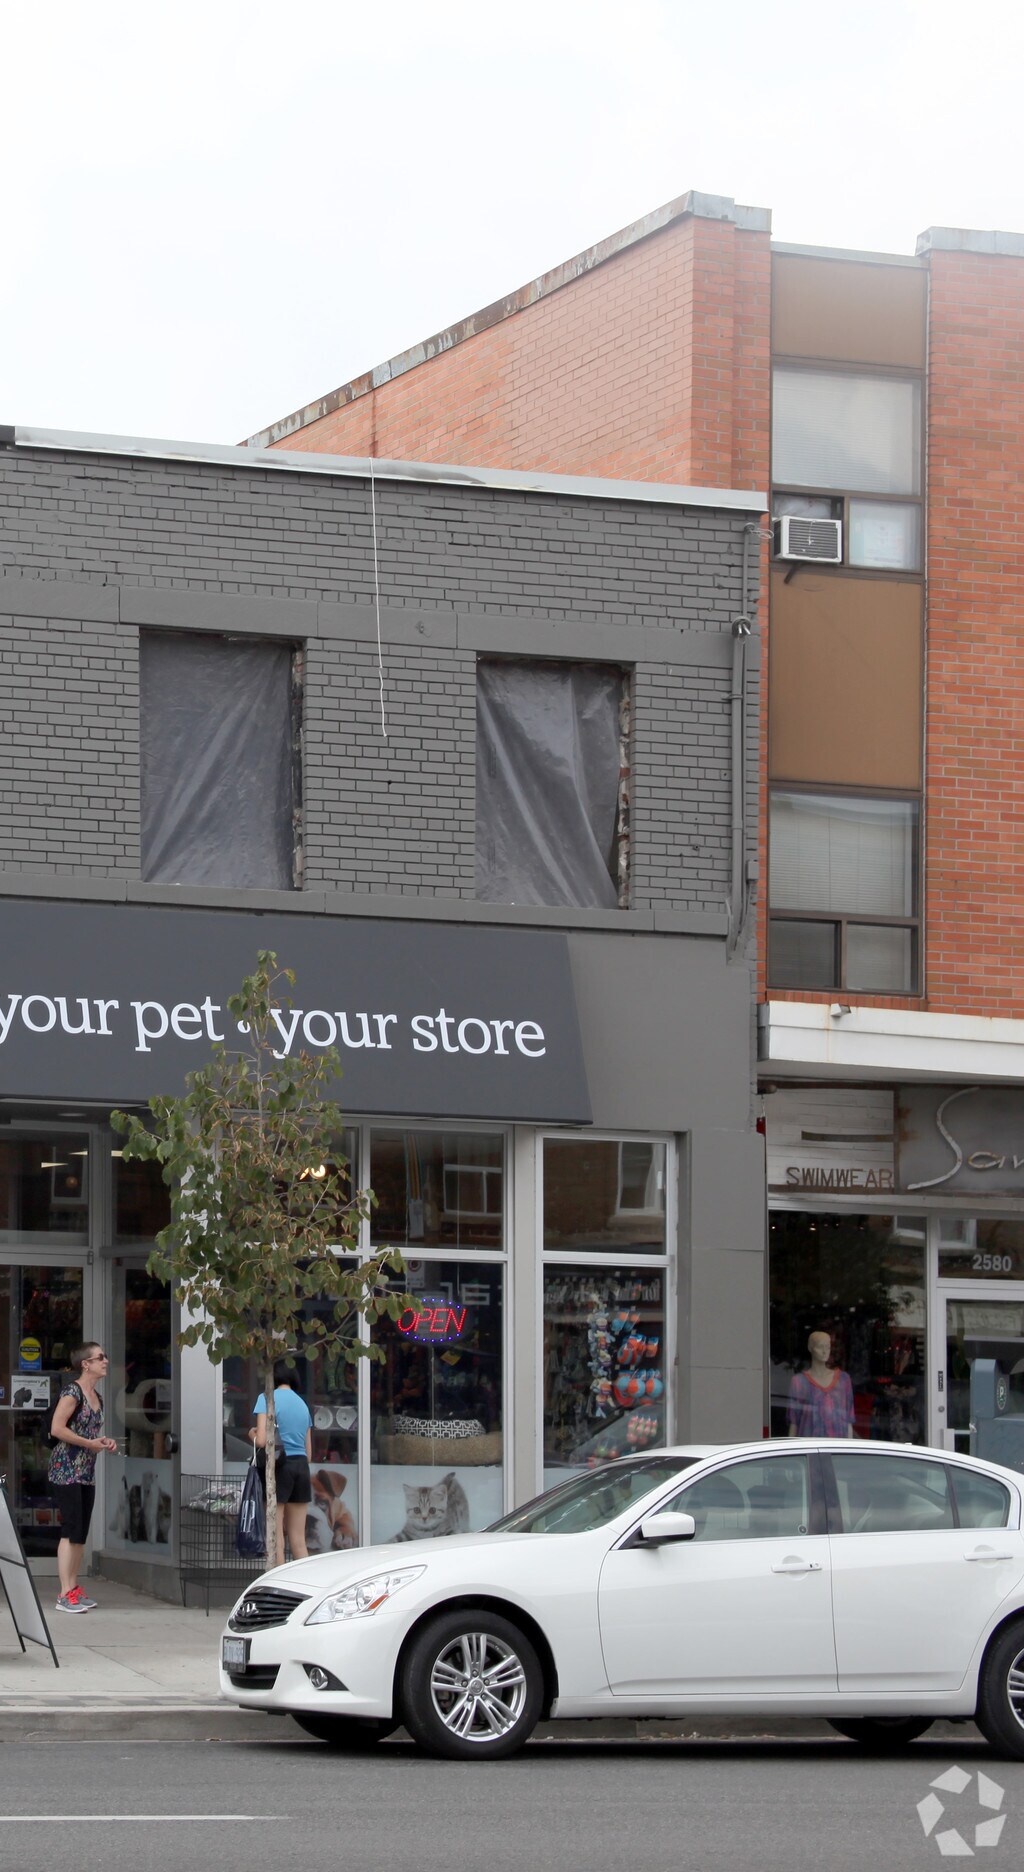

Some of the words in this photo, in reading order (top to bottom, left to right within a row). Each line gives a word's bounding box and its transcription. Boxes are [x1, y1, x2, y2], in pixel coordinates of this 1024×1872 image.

[130, 996, 225, 1053] pet
[269, 1007, 398, 1058] your
[411, 1007, 546, 1058] store
[786, 1166, 893, 1189] SWIMWEAR
[972, 1254, 1012, 1272] 2580
[397, 1307, 467, 1333] OPEN
